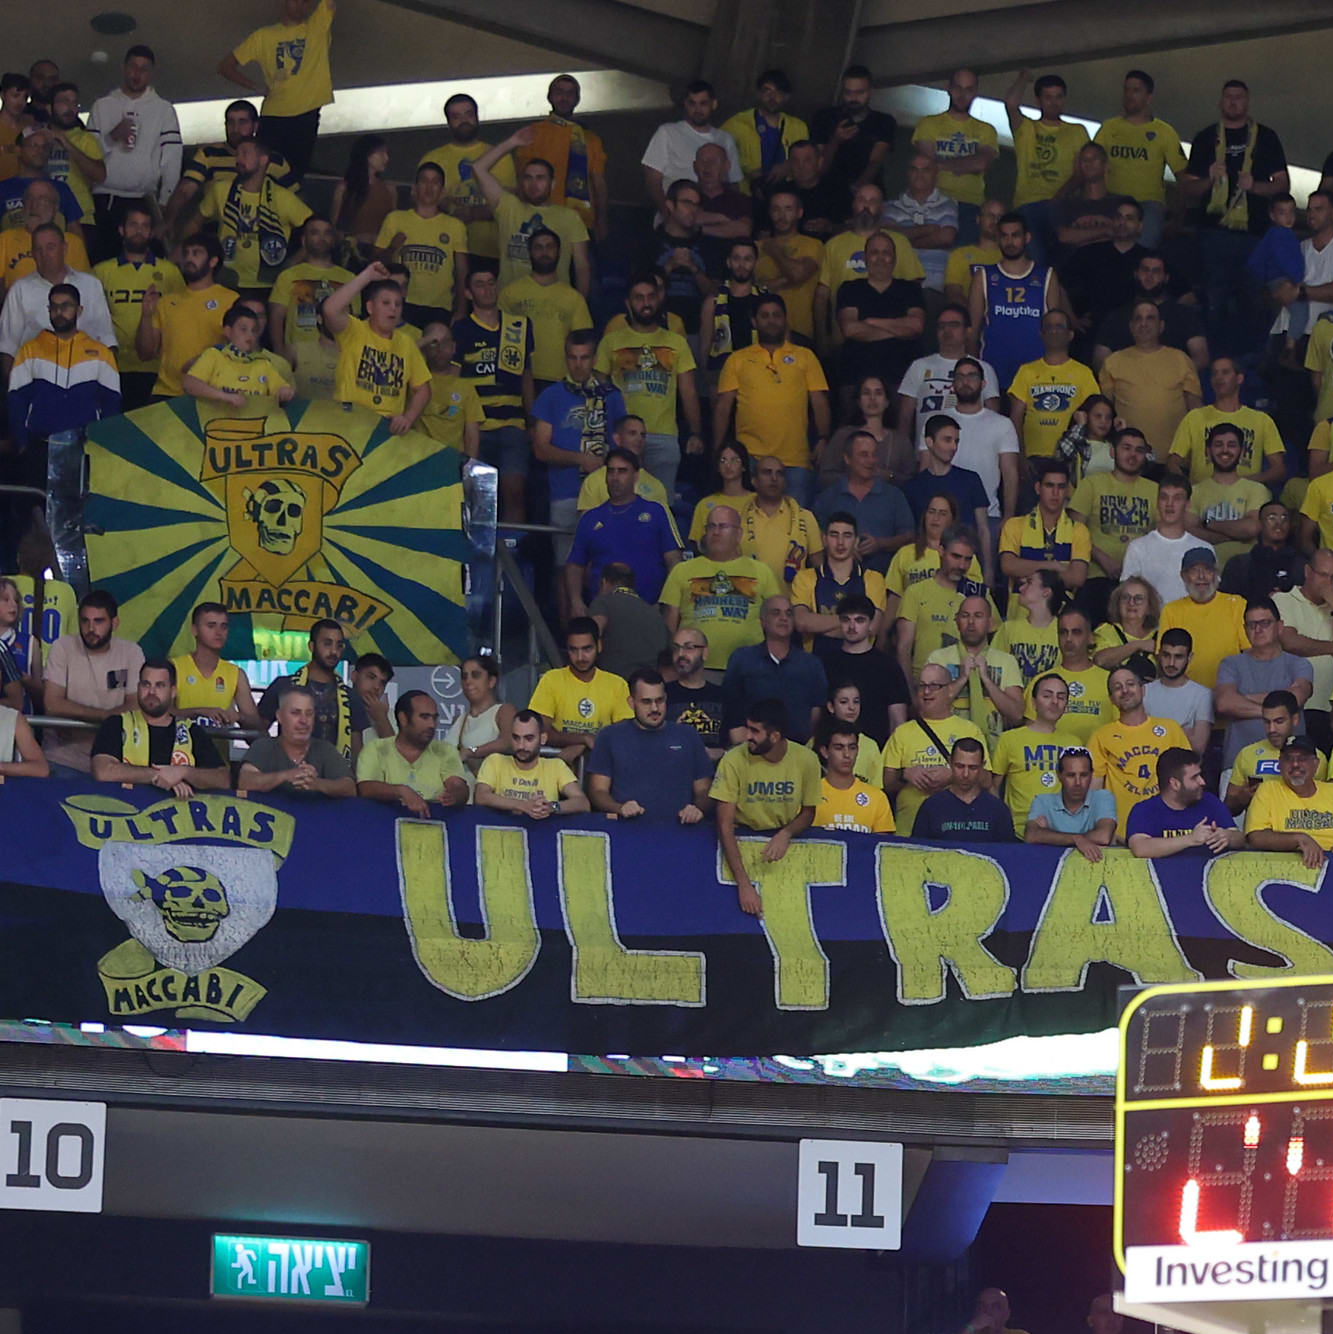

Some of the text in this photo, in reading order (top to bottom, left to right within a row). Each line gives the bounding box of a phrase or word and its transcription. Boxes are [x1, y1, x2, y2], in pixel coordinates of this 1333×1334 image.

[1110, 146, 1149, 160] BBVA
[994, 304, 1041, 319] Playtika
[1005, 287, 1026, 302] 12
[209, 441, 352, 478] ULTRAS
[226, 584, 377, 630] MACCABI
[747, 781, 795, 797] UM96
[1137, 764, 1150, 779] 4
[89, 804, 277, 846] ULTRAS
[113, 971, 241, 1014] MACCABI
[4, 1120, 95, 1188] 10
[813, 1159, 886, 1229] 11
[267, 1241, 358, 1298] יציאה
